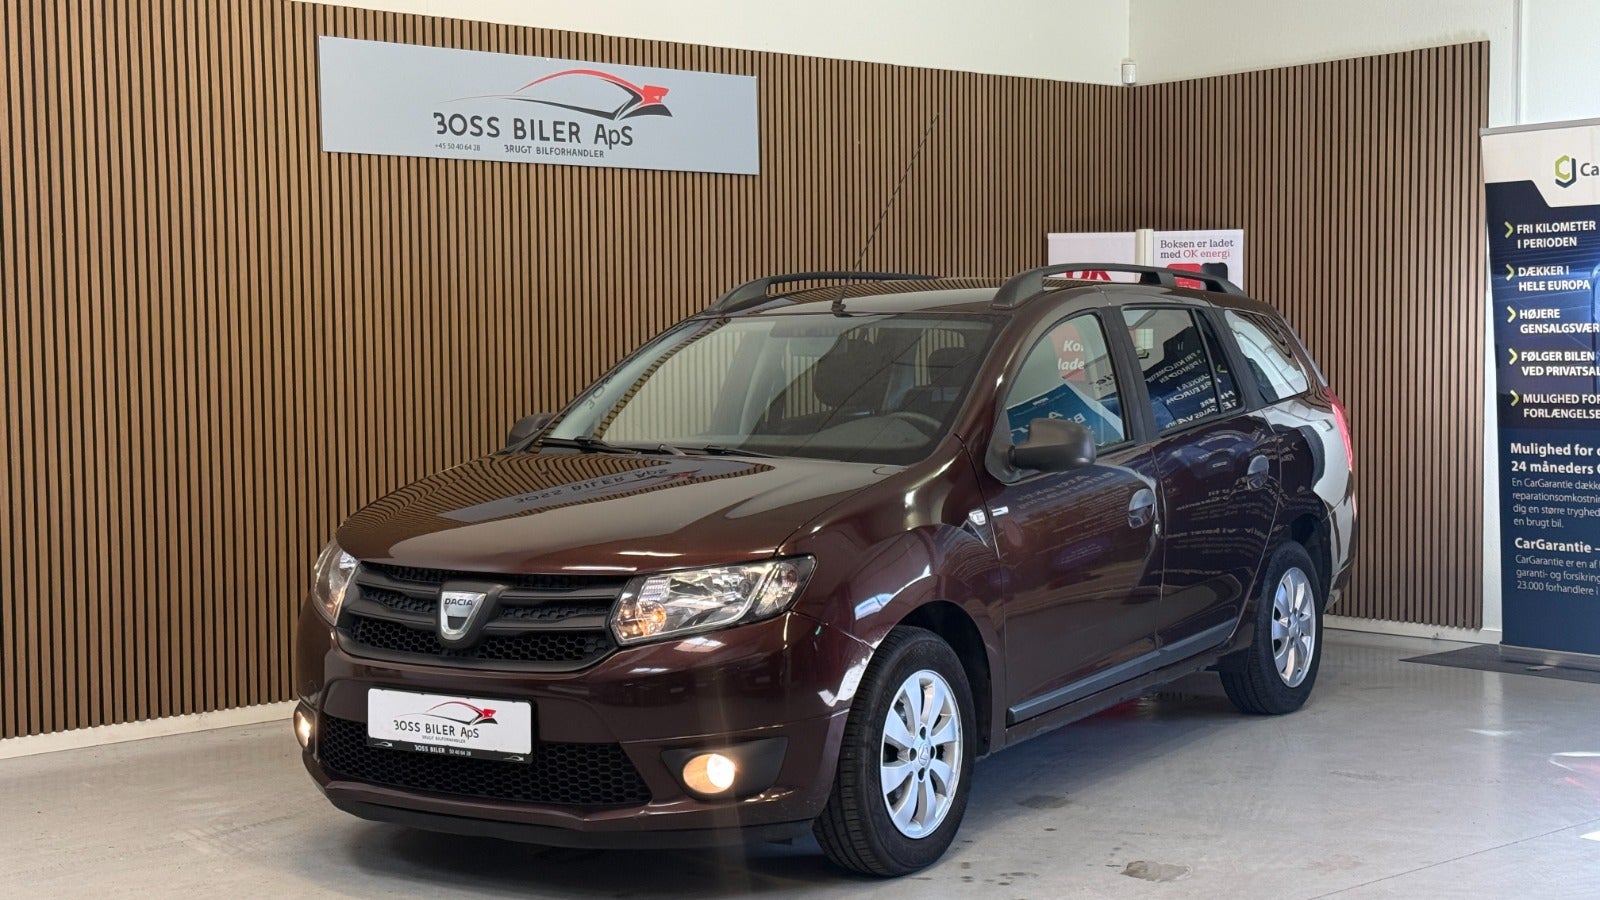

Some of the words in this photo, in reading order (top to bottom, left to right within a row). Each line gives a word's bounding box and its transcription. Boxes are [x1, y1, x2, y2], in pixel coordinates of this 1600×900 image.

[513, 117, 582, 144] BILER
[593, 123, 634, 150] ApS
[536, 146, 605, 158] BILFORHANDLER
[1516, 224, 1533, 234] FRI
[1535, 220, 1597, 233] KILOMETER
[1160, 239, 1195, 249] Boksen
[1196, 240, 1208, 248] er
[1209, 238, 1235, 248] ladet
[1517, 239, 1521, 249] I
[1523, 236, 1578, 249] PERIODEN
[1160, 250, 1181, 259] med
[1183, 249, 1199, 258] OK
[1200, 249, 1231, 260] energi
[1518, 266, 1564, 277] DÆKKER
[1566, 265, 1570, 275] I
[1518, 281, 1546, 292] HELE
[1547, 280, 1591, 291] EUROPA
[1519, 308, 1561, 320] HØJERE
[1520, 322, 1600, 334] GENSALGSVÆR
[1521, 351, 1563, 362] FØLGER
[1564, 351, 1595, 362] BILEN
[1521, 366, 1545, 376] VED
[1523, 393, 1579, 404] MULIGHED
[1510, 442, 1571, 458] Mulighed
[1574, 443, 1594, 456] for
[1511, 460, 1527, 472] 24
[1530, 460, 1594, 475] måneders
[1511, 478, 1522, 487] En
[1524, 478, 1574, 489] CarGarantie
[1513, 503, 1527, 515] dig
[1528, 506, 1540, 514] en
[1541, 505, 1565, 515] større
[1513, 518, 1525, 526] en
[1526, 516, 1550, 529] brugt
[1514, 537, 1592, 554] CarGarantie
[1515, 554, 1565, 567] CarGarantie
[1565, 560, 1574, 568] er
[1575, 560, 1588, 569] en
[1589, 559, 1598, 569] af
[1550, 572, 1562, 582] og
[1517, 580, 1545, 591] 23.000
[1545, 583, 1594, 596] forhandlere
[444, 598, 473, 606] DACIA
[425, 723, 456, 737] BILER
[460, 726, 480, 740] ApS
[430, 746, 446, 754] BILER
